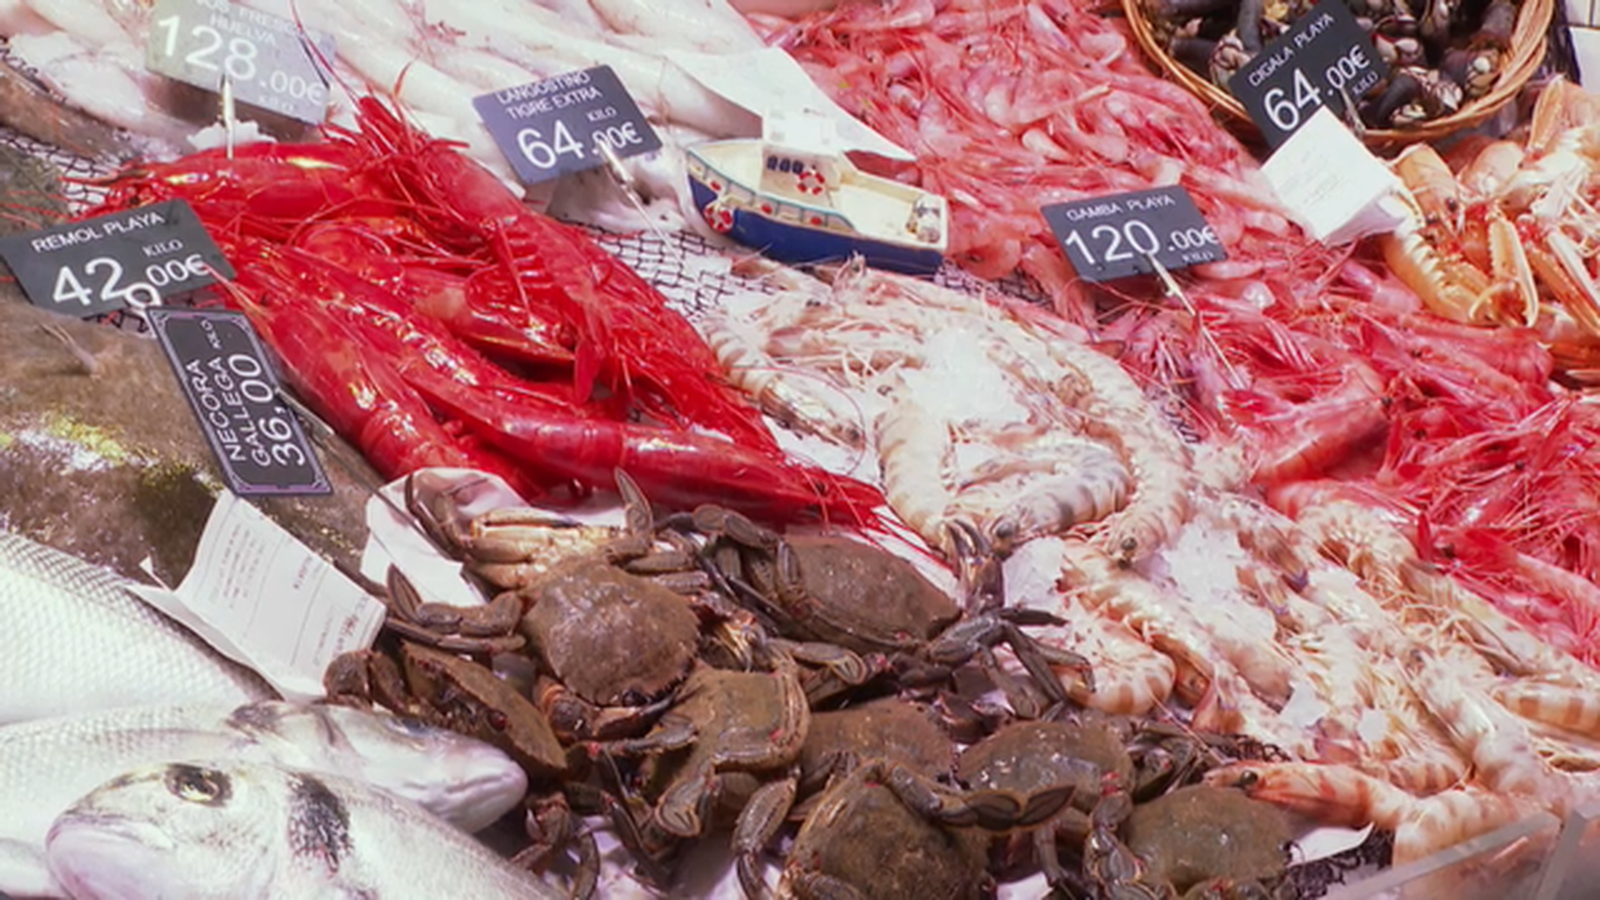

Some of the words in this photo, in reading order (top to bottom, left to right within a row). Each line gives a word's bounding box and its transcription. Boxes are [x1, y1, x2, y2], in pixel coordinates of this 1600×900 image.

[210, 14, 277, 46] HUELVA
[1248, 46, 1296, 88] CIGALA
[1294, 13, 1335, 49] PLAYA
[158, 15, 325, 106] 128.00€
[505, 97, 553, 120] TIGRE
[552, 86, 604, 109] EXTRA
[1263, 44, 1371, 132] 64.00€
[586, 106, 617, 122] KILO
[1066, 204, 1124, 222] GAMBA
[1126, 194, 1177, 212] PLAYA
[31, 226, 103, 254] REMOL
[102, 212, 166, 236] PLAYA
[142, 239, 184, 258] KILO
[1065, 219, 1219, 266] 120.00€
[200, 318, 222, 350] KILO
[186, 358, 246, 462] NECORA
[207, 356, 271, 467] GALLEGA
[228, 354, 306, 467] 36,00
